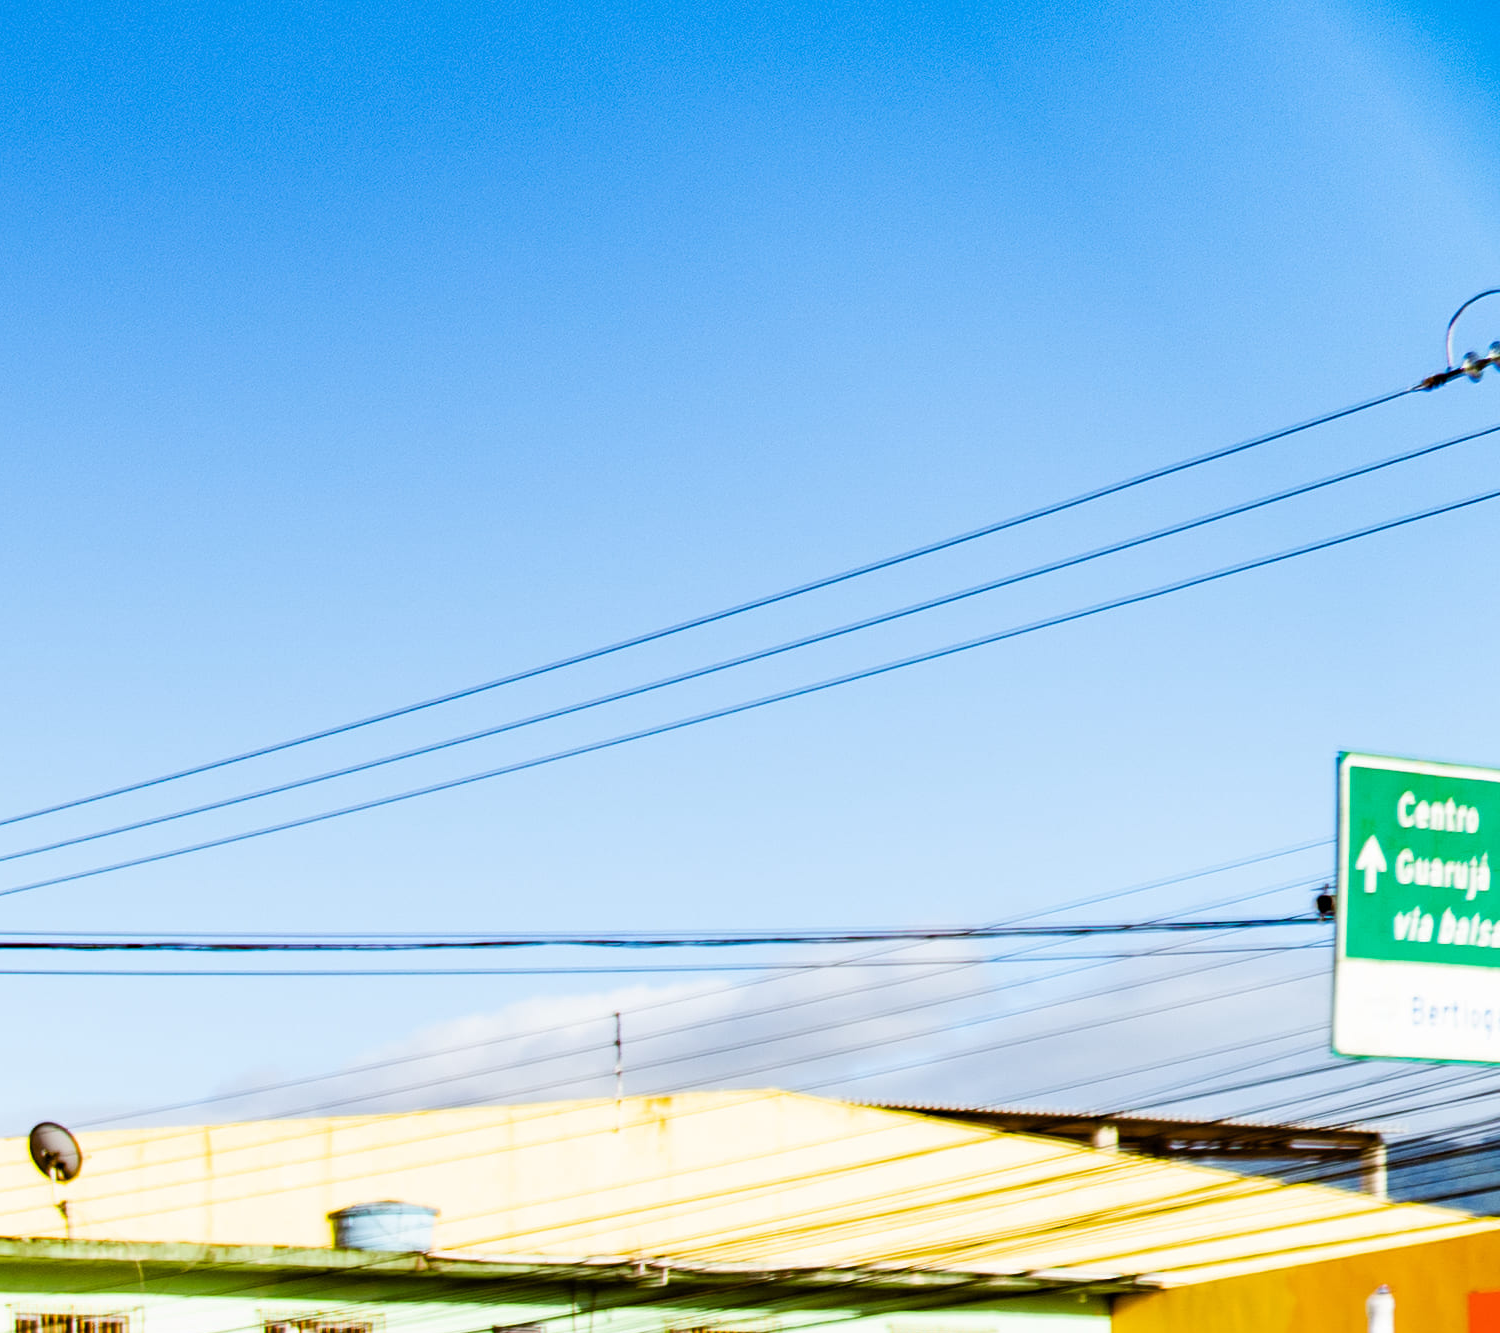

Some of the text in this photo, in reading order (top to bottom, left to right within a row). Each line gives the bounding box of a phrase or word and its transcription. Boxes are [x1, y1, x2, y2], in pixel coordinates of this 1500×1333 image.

[1397, 790, 1479, 834] Centro
[1395, 848, 1491, 901] Guarujá
[1393, 905, 1434, 943] via
